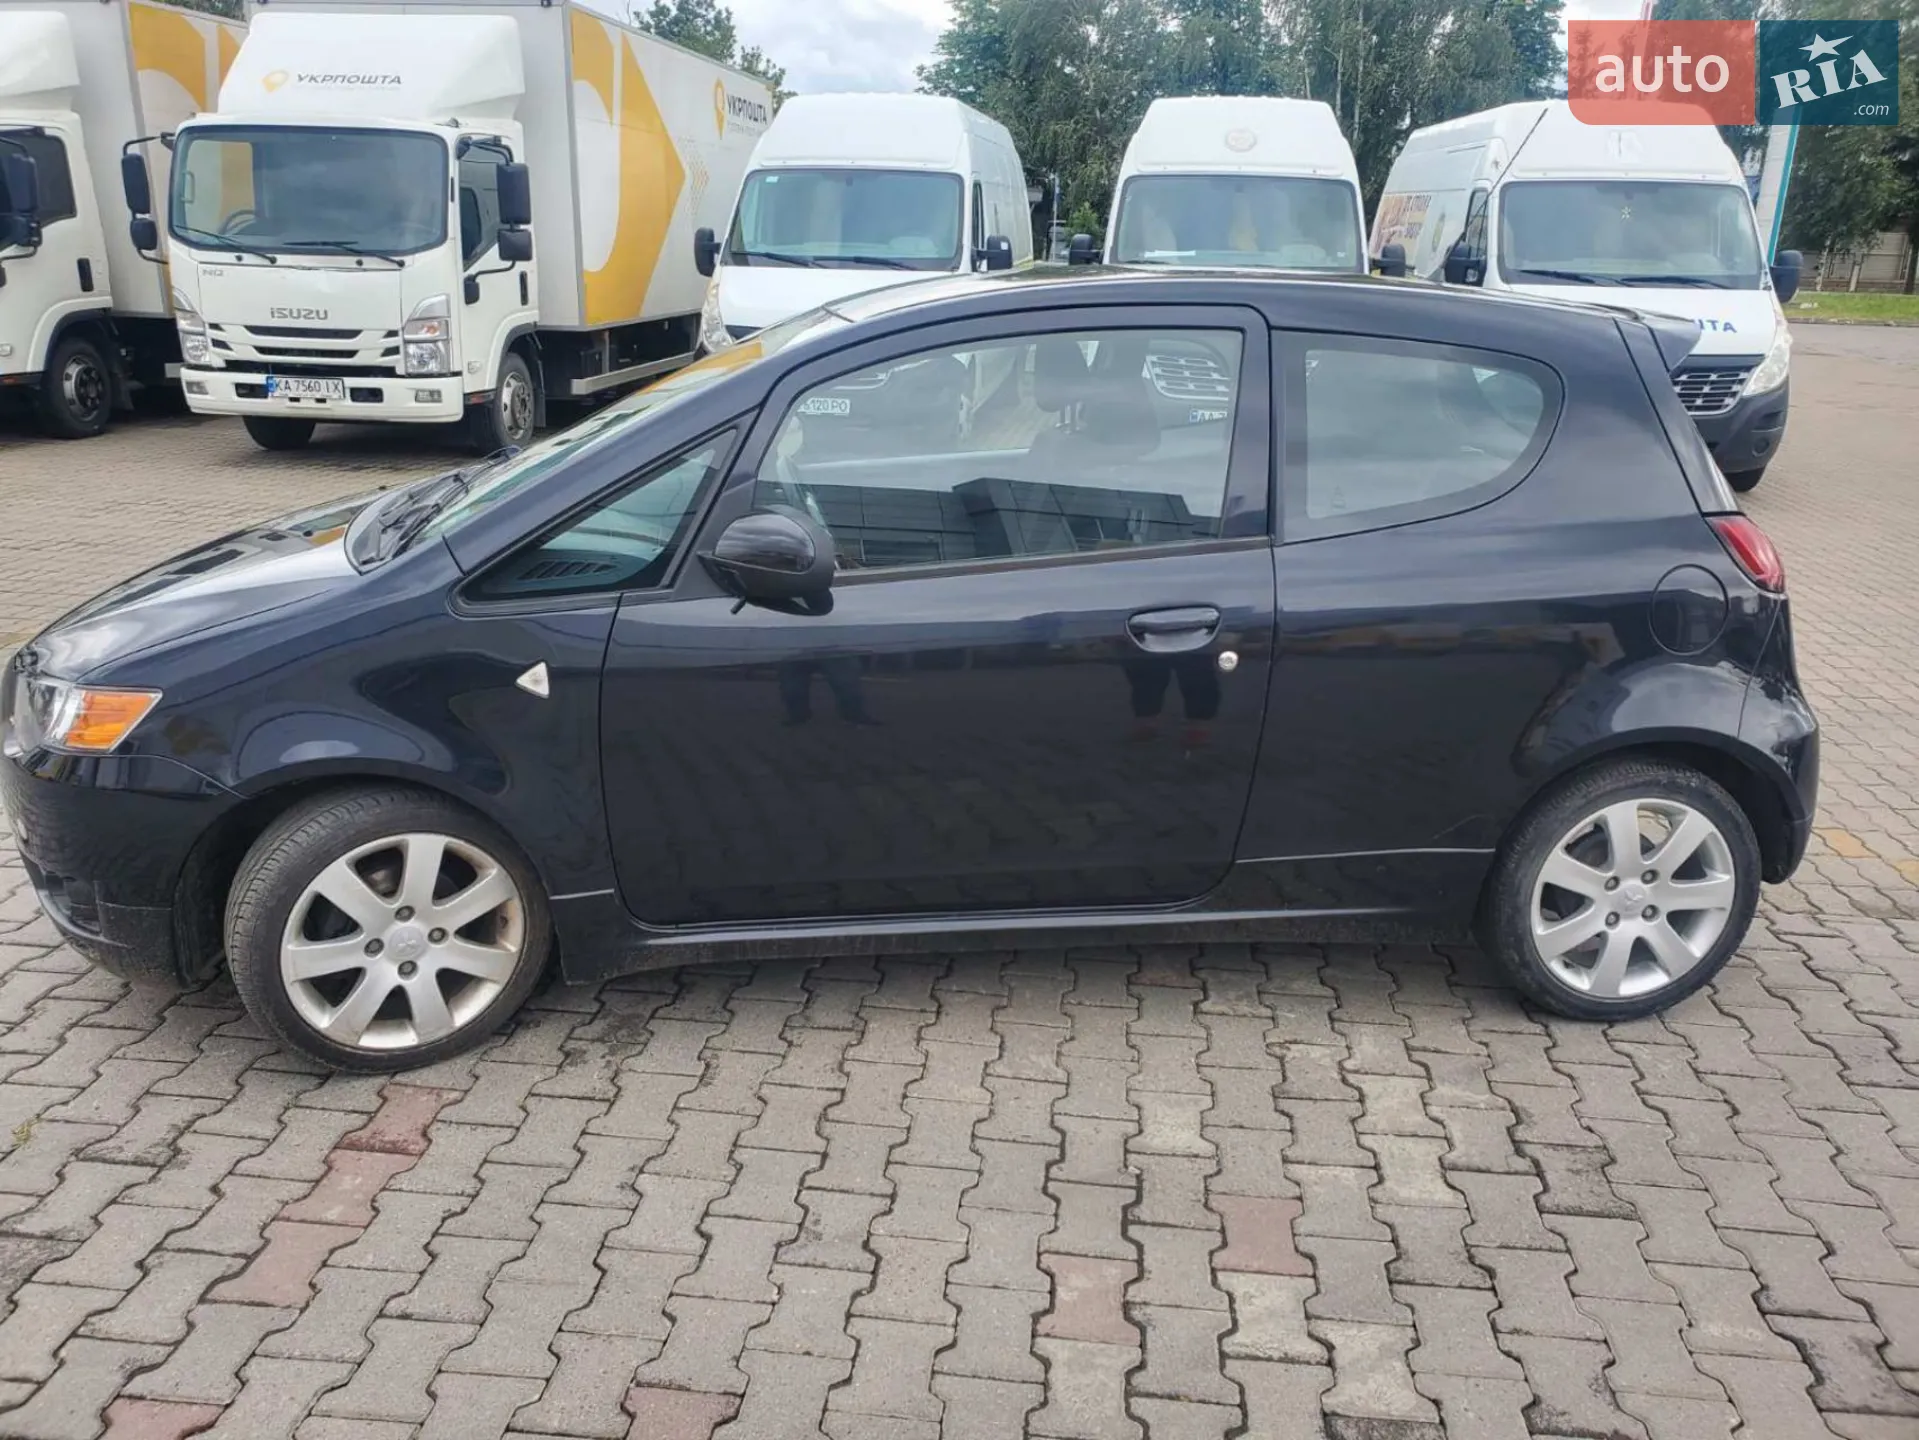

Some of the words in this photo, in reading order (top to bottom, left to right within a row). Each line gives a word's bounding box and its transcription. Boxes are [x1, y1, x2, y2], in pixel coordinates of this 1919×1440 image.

[297, 73, 402, 85] УКРПОШТА
[726, 93, 768, 125] УКРПОШТА
[270, 307, 328, 320] ISUZU
[275, 379, 292, 392] KA
[294, 380, 321, 393] 7560
